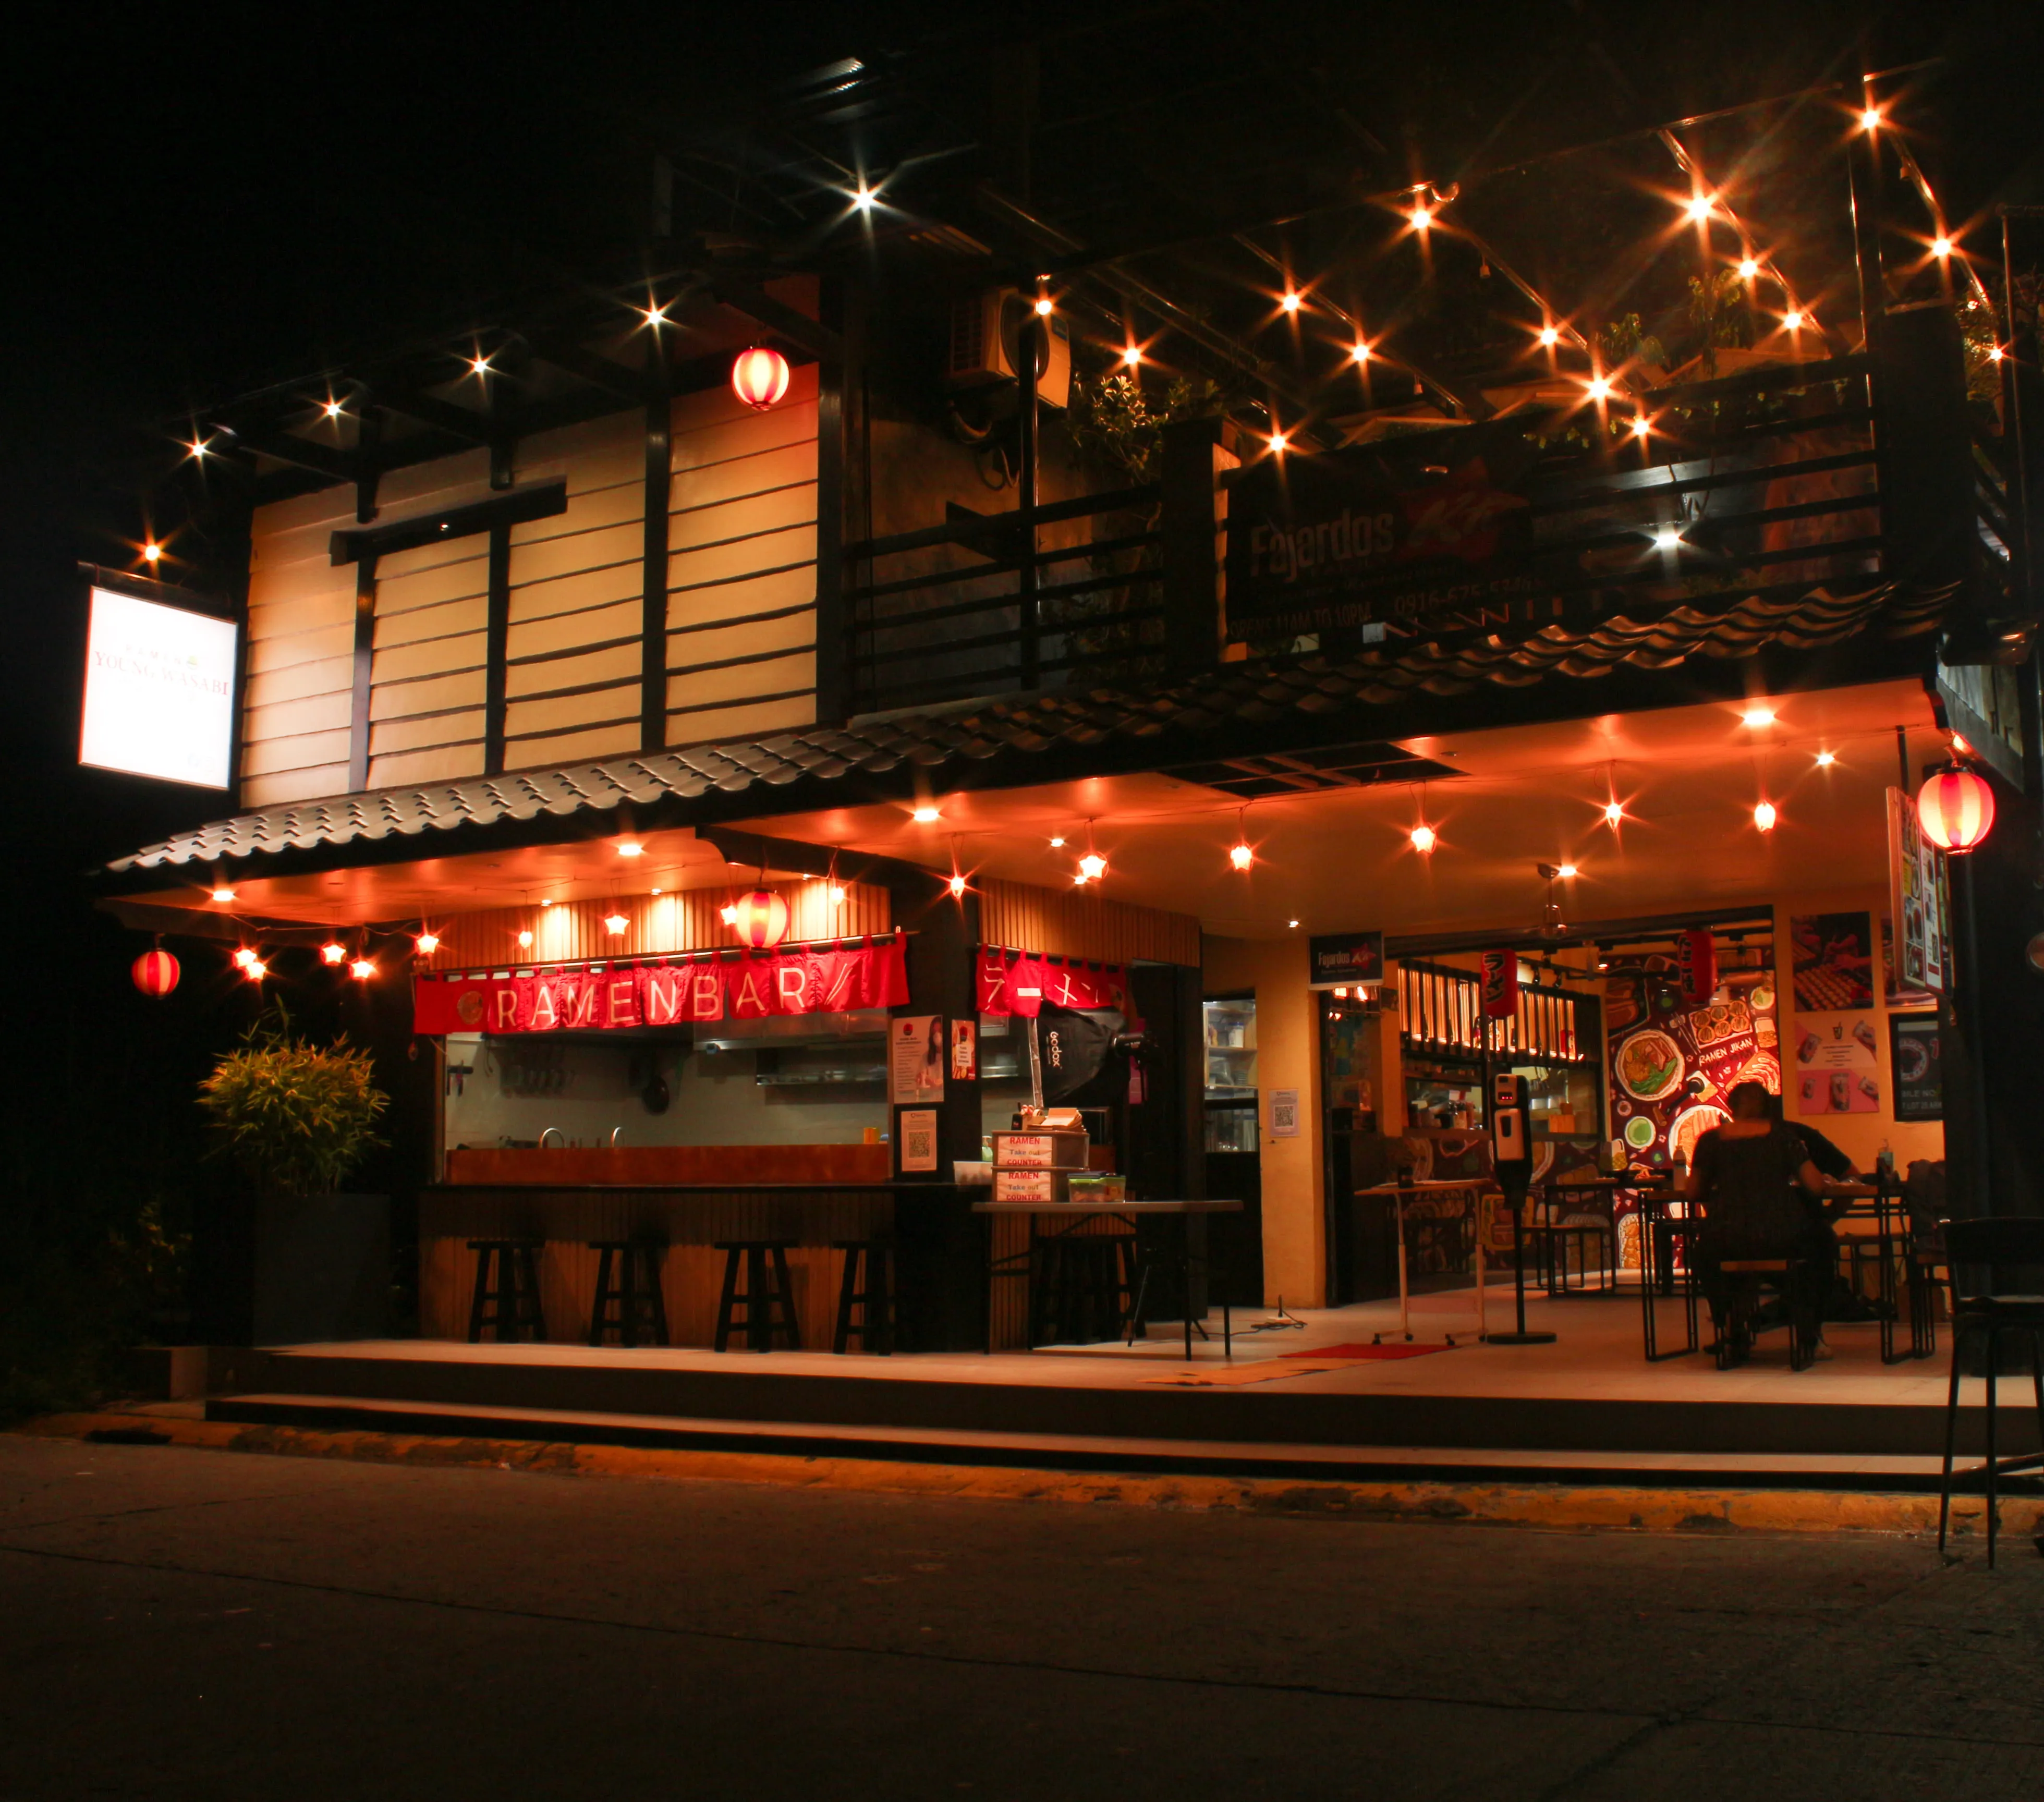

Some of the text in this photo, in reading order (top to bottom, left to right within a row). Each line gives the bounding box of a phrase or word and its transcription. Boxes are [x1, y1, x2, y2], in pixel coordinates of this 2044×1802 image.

[1250, 507, 1394, 583] Fajardos
[94, 651, 156, 678] YOUNG
[161, 667, 230, 696] WASABI
[1318, 950, 1350, 968] Fajardos
[1483, 953, 1504, 1004] ラーメン
[1050, 1031, 1063, 1067] Godox
[1698, 1046, 1728, 1067] RAMEN
[1730, 1037, 1754, 1053] JIKAN
